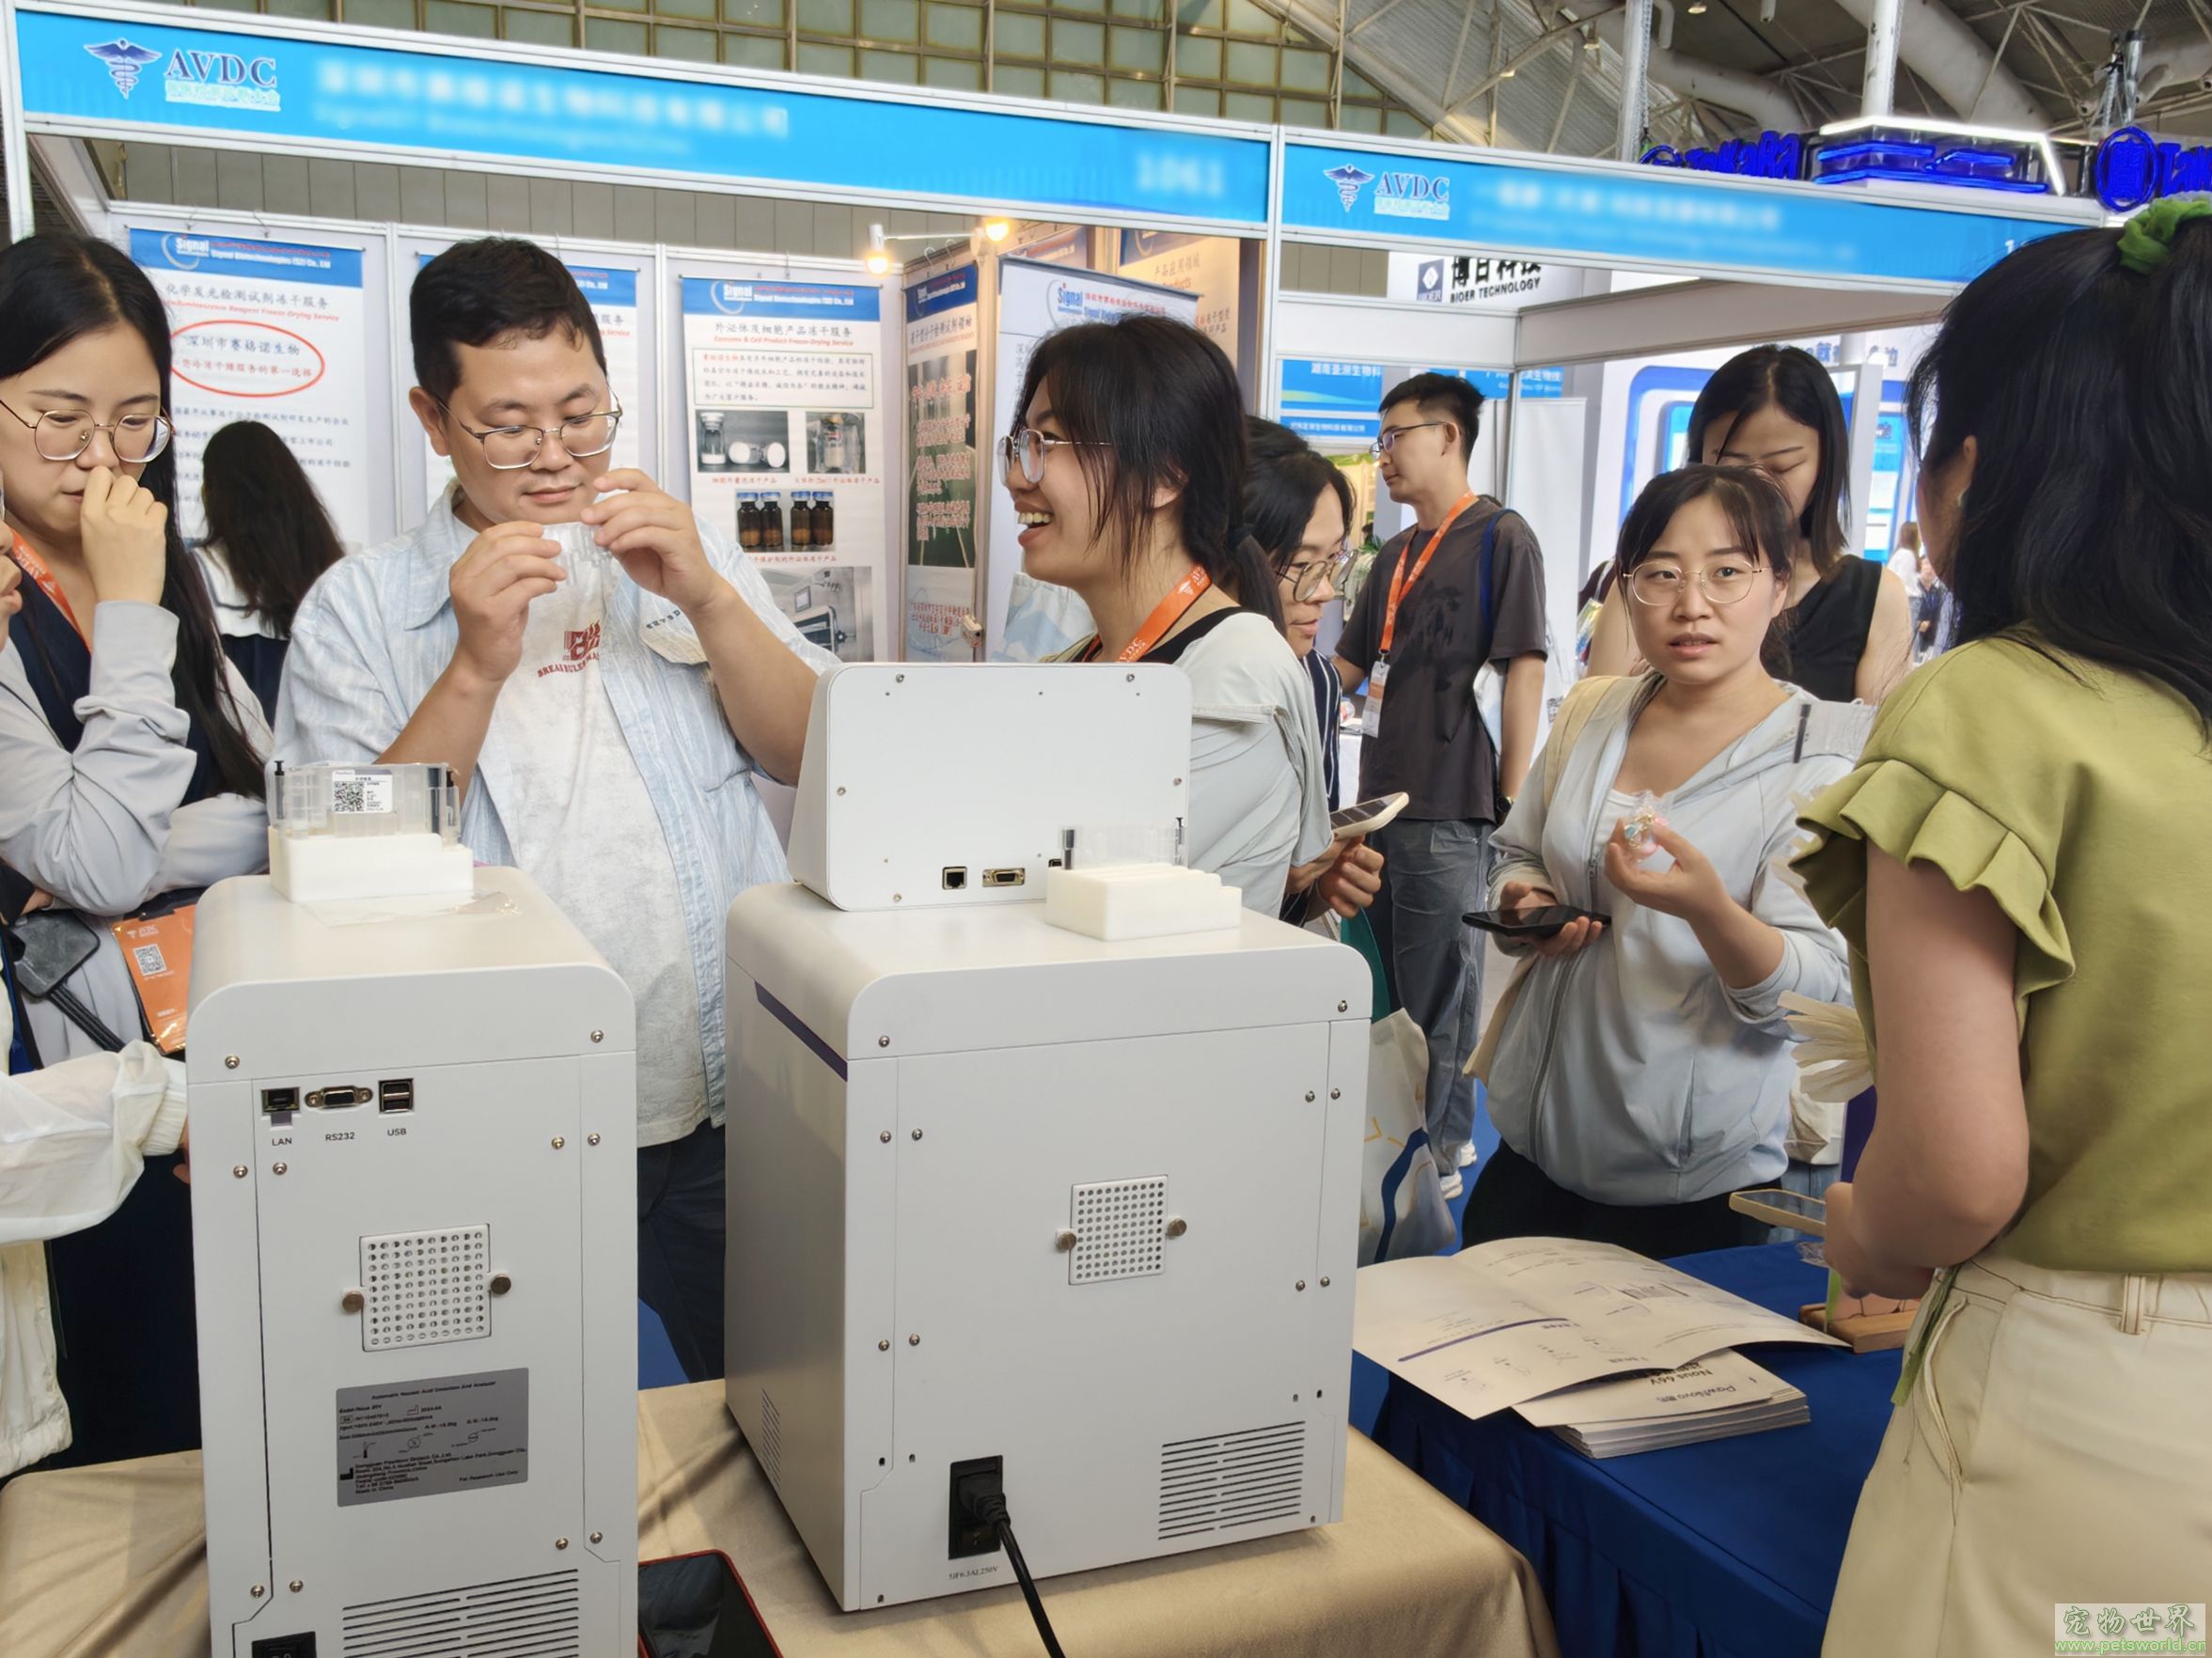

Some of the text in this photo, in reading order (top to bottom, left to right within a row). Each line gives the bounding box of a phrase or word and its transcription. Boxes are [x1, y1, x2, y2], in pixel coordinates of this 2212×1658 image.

[164, 49, 277, 87] AVDC
[1375, 172, 1450, 201] AVDC
[166, 283, 329, 310] 化学发光检测试剂冻干服务
[1058, 283, 1083, 307] Signal
[1451, 277, 1541, 304] BIOER TECHNOLOGY
[715, 322, 853, 338] 外泌体及细胞产品冻干服务
[272, 1137, 292, 1147] LAN
[316, 1132, 355, 1142] RS232
[387, 1128, 407, 1136] USB
